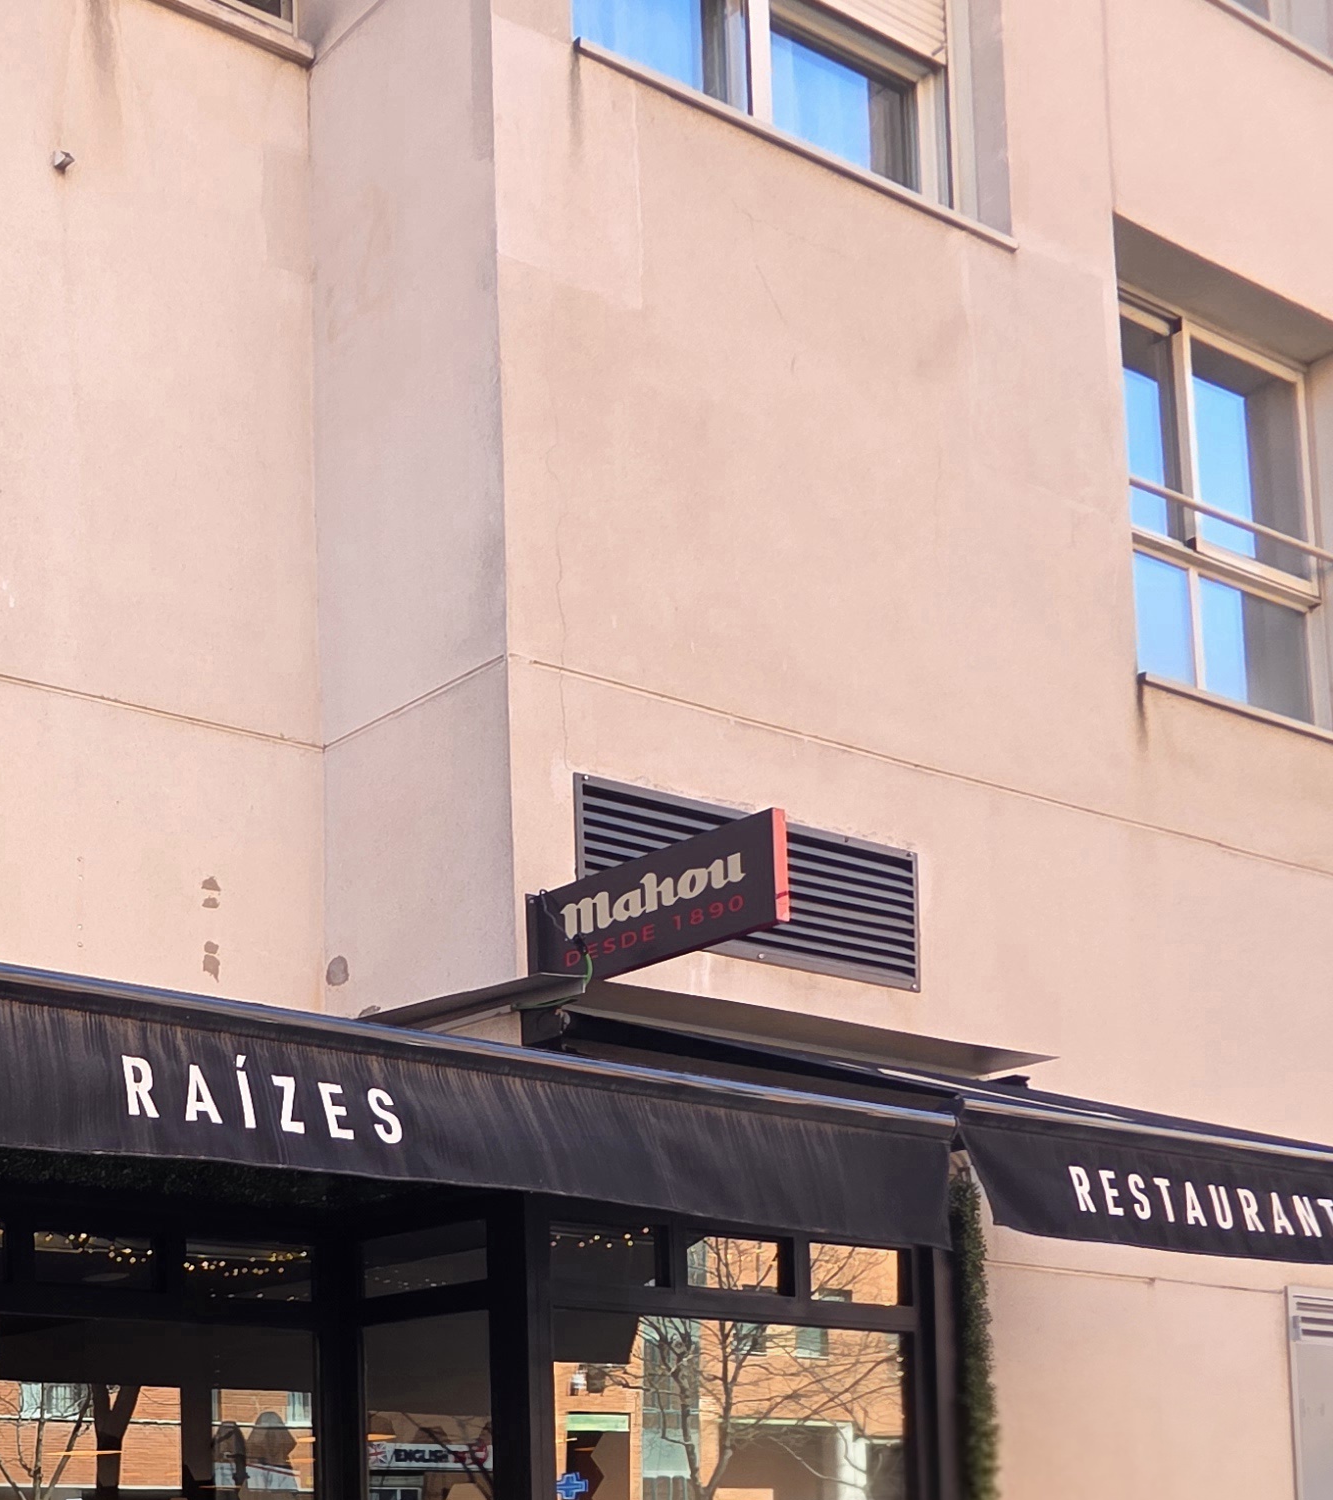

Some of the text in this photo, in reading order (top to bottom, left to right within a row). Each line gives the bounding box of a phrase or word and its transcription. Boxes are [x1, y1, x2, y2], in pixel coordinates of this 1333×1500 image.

[560, 851, 747, 940] Mahou
[564, 893, 746, 968] DESDE 1890
[121, 1054, 403, 1144] RAÍZES
